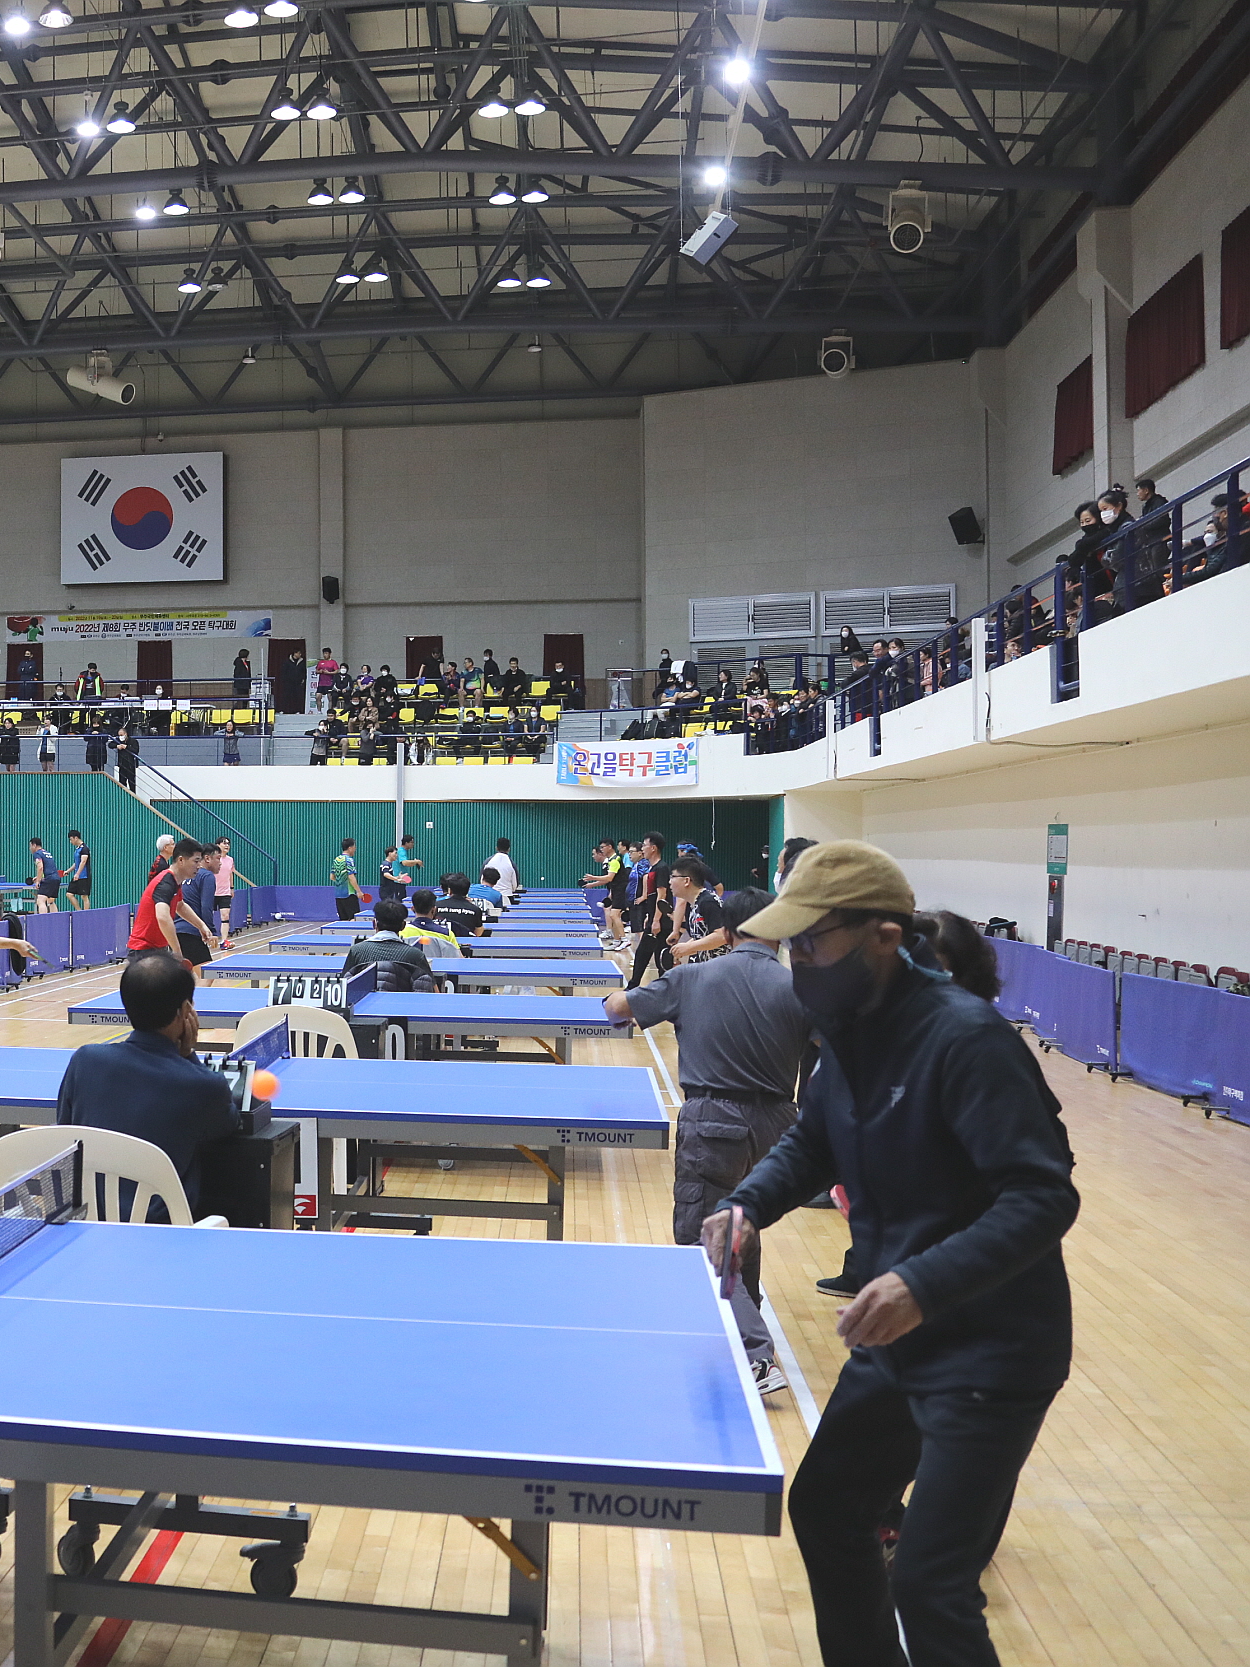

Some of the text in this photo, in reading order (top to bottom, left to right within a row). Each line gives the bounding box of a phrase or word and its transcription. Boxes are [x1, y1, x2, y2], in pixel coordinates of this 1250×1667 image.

[51, 625, 74, 634] muju
[75, 622, 101, 633] 2022년
[102, 622, 121, 632] 제8회
[122, 622, 137, 632] 무주
[191, 620, 207, 631] 오픈
[208, 619, 237, 630] 탁구대회
[573, 748, 689, 777] 온고을탁구클럽
[277, 982, 342, 1006] 7 0 2 10
[100, 1015, 131, 1024] TMOUN
[573, 1027, 612, 1036] TMOUNT
[576, 1131, 635, 1143] TMOUNT
[568, 1491, 702, 1521] TMOUNT
